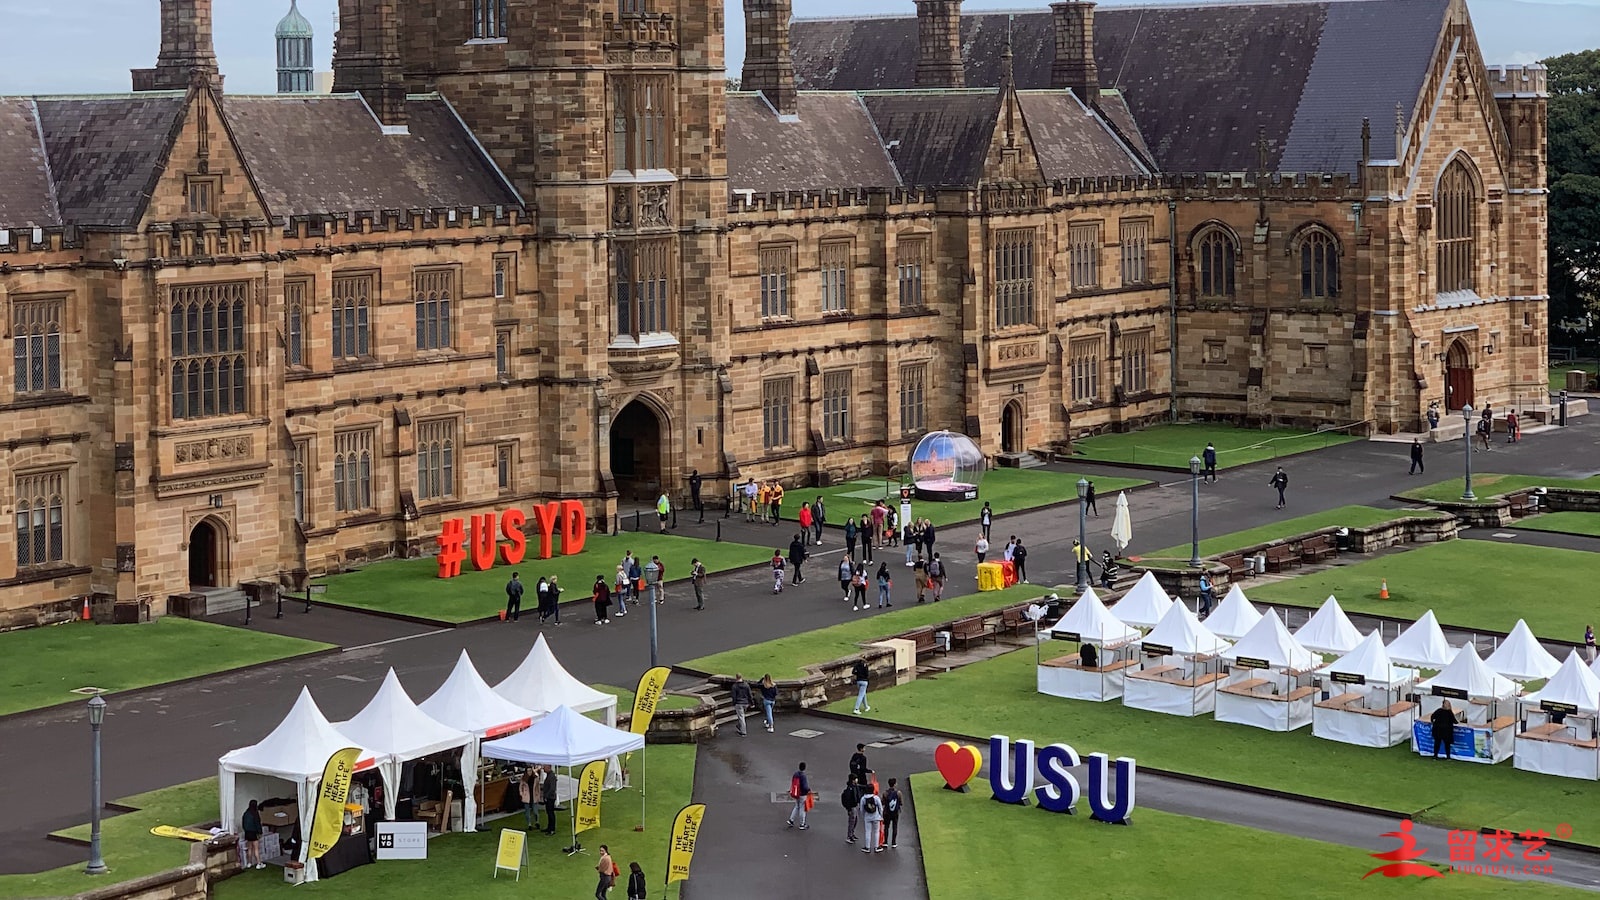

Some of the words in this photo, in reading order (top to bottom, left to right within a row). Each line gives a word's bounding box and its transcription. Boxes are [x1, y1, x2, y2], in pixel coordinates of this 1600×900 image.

[437, 499, 587, 578] #USYD
[640, 687, 652, 711] HEART
[649, 676, 655, 686] OF
[646, 701, 654, 713] UNI
[651, 685, 659, 699] LIFE
[324, 782, 333, 798] THE
[331, 774, 341, 802] HEART
[338, 760, 345, 773] OF
[341, 768, 349, 787] LIFE
[989, 734, 1136, 823] USU
[337, 788, 346, 803] UNI
[686, 814, 692, 824] OF
[682, 826, 691, 852] HEART
